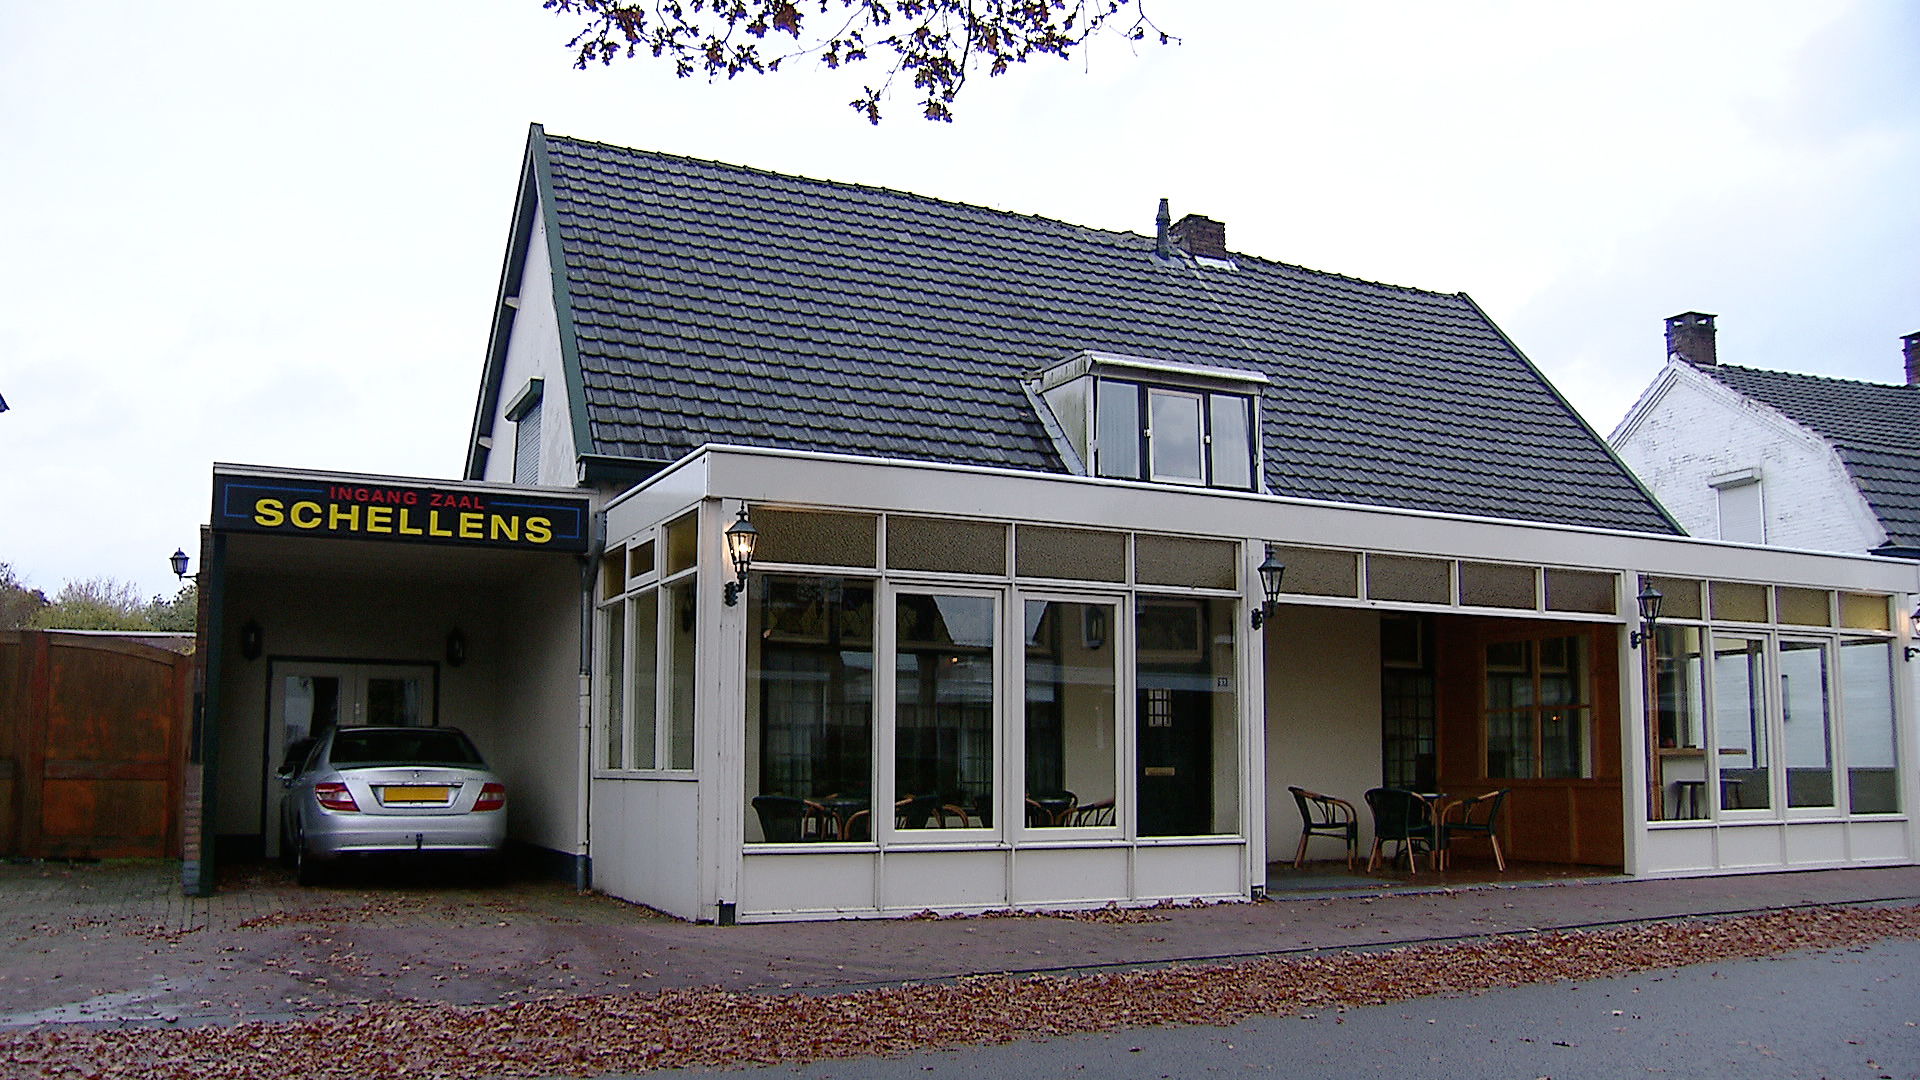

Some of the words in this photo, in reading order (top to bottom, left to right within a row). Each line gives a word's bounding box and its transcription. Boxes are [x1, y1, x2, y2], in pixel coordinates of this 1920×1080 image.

[329, 486, 418, 505] INGANG
[429, 493, 485, 510] ZAAL
[254, 498, 553, 543] SCHELLENS
